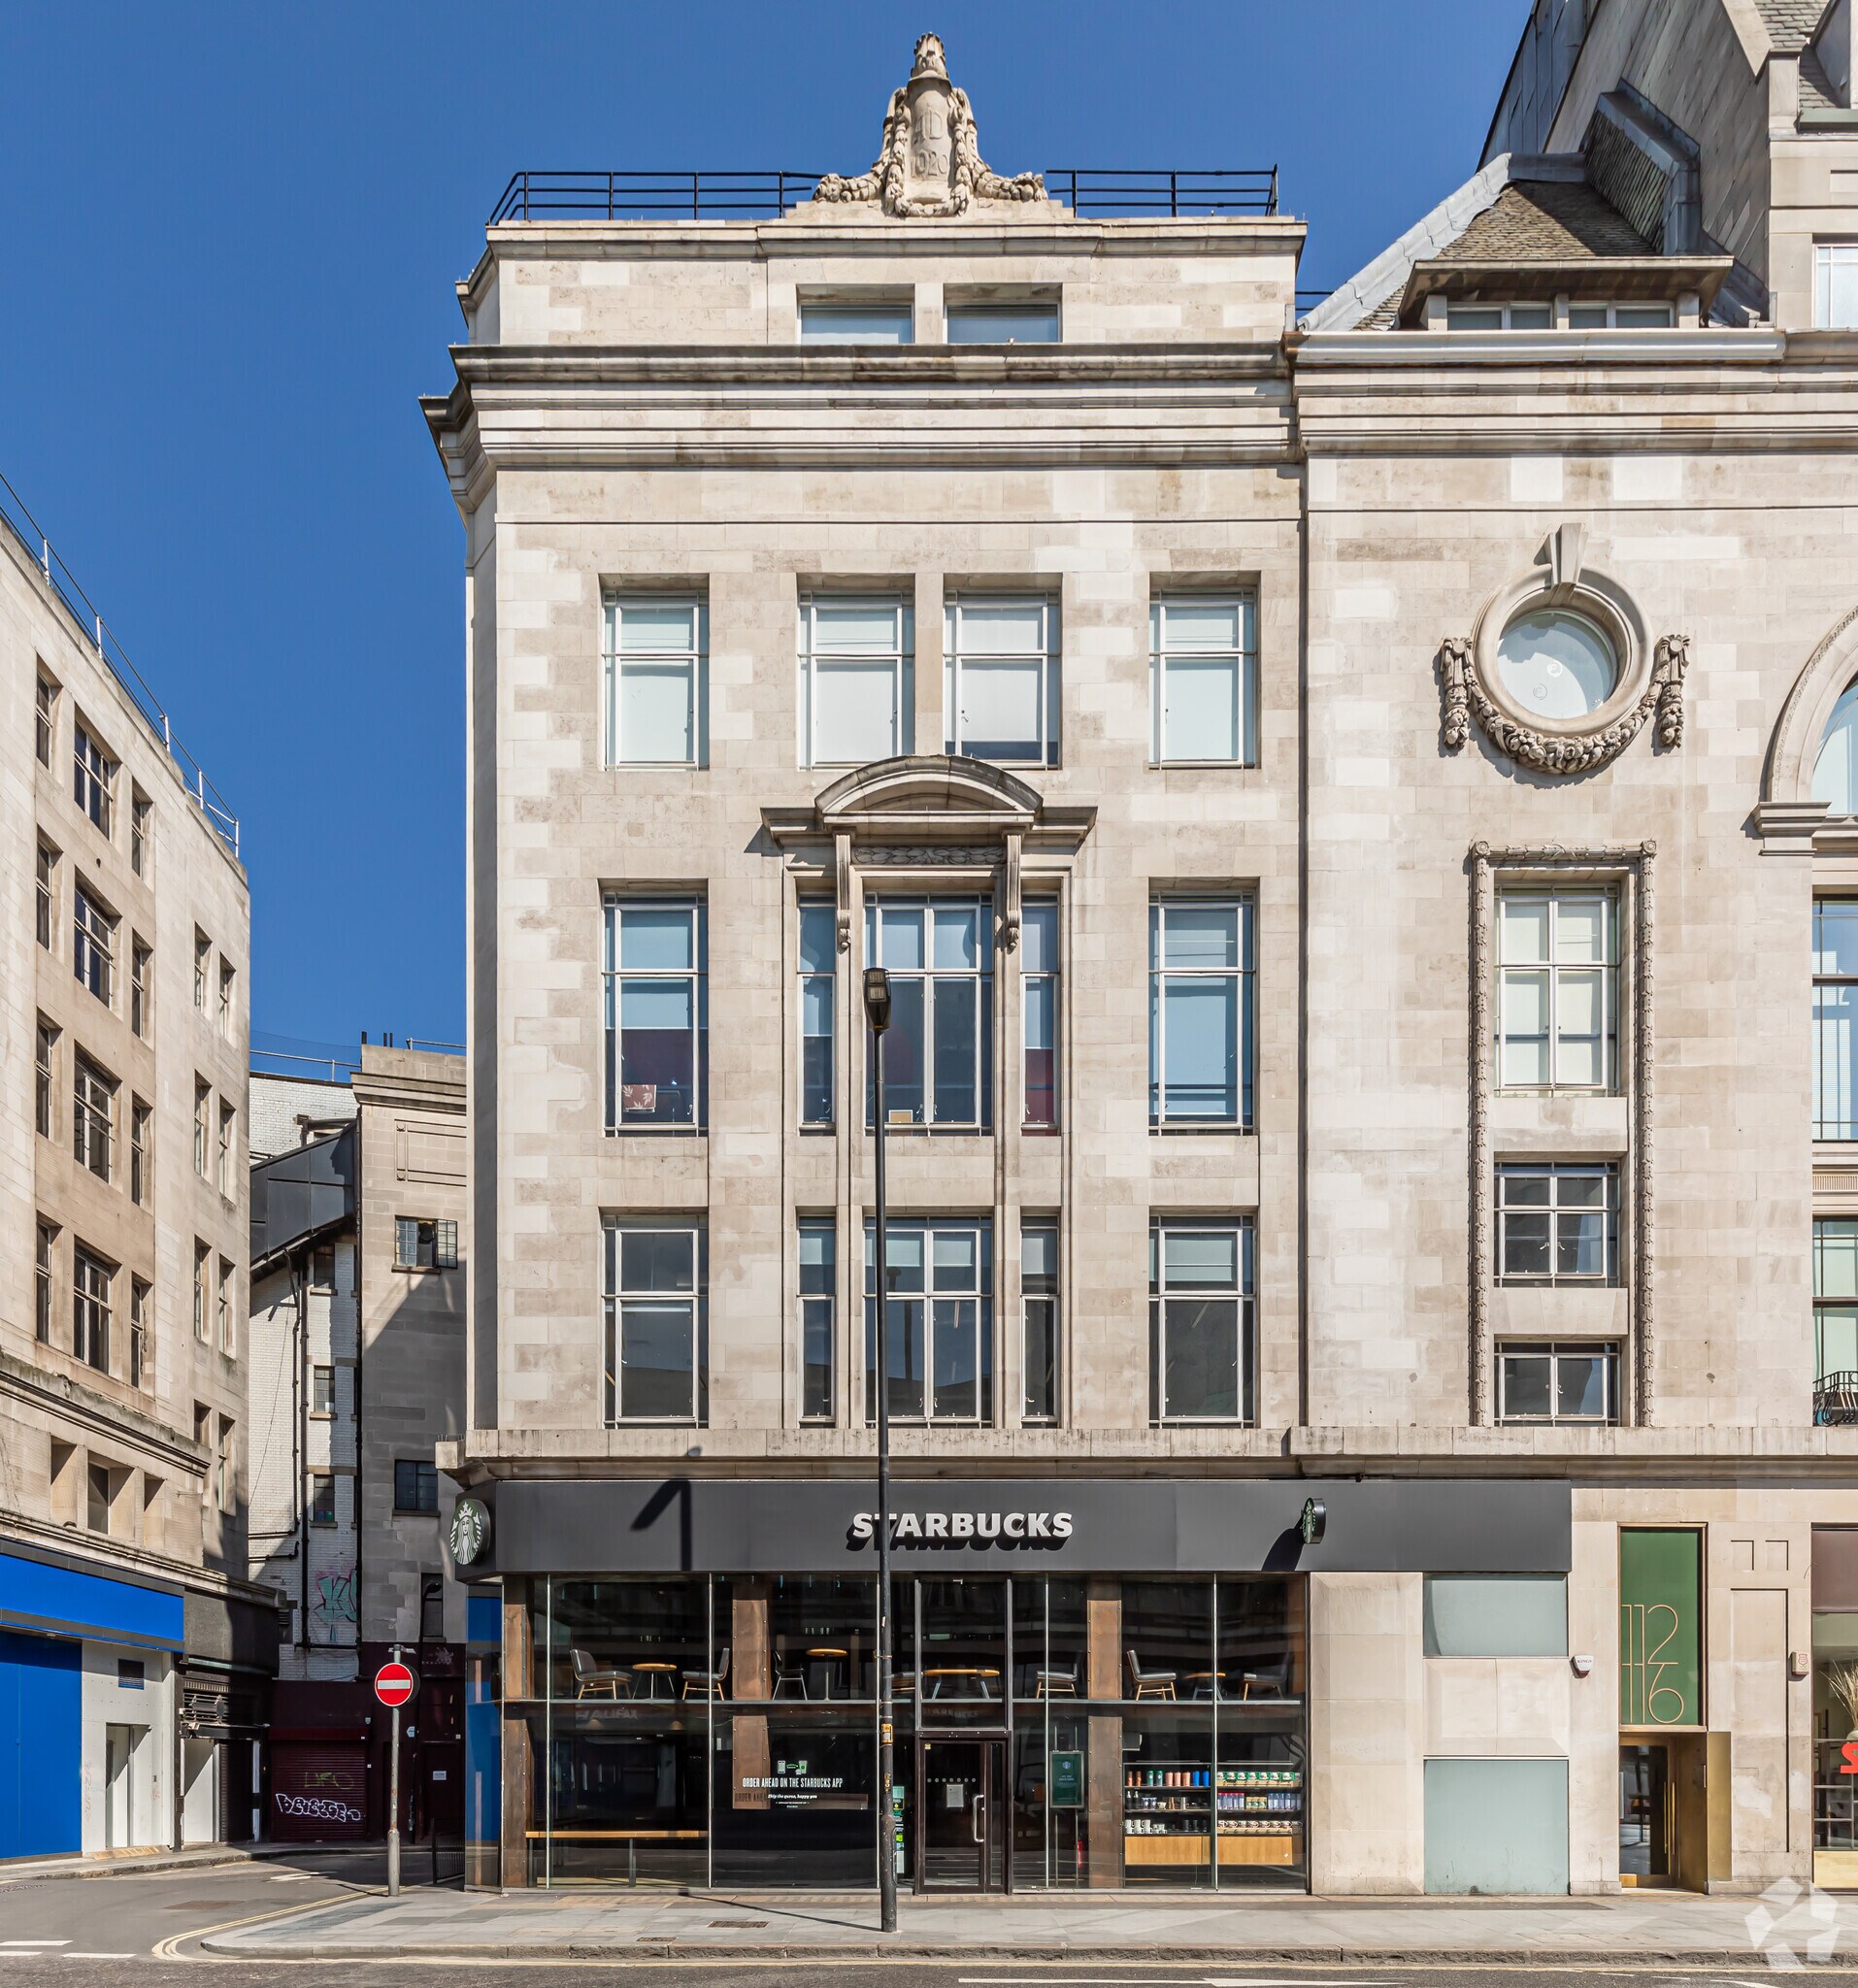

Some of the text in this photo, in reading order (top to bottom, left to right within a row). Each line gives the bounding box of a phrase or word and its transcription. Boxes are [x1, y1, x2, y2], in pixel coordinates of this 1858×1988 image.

[743, 1777, 843, 1788] ORDER AHEAD ON THE STARBUCKS APP
